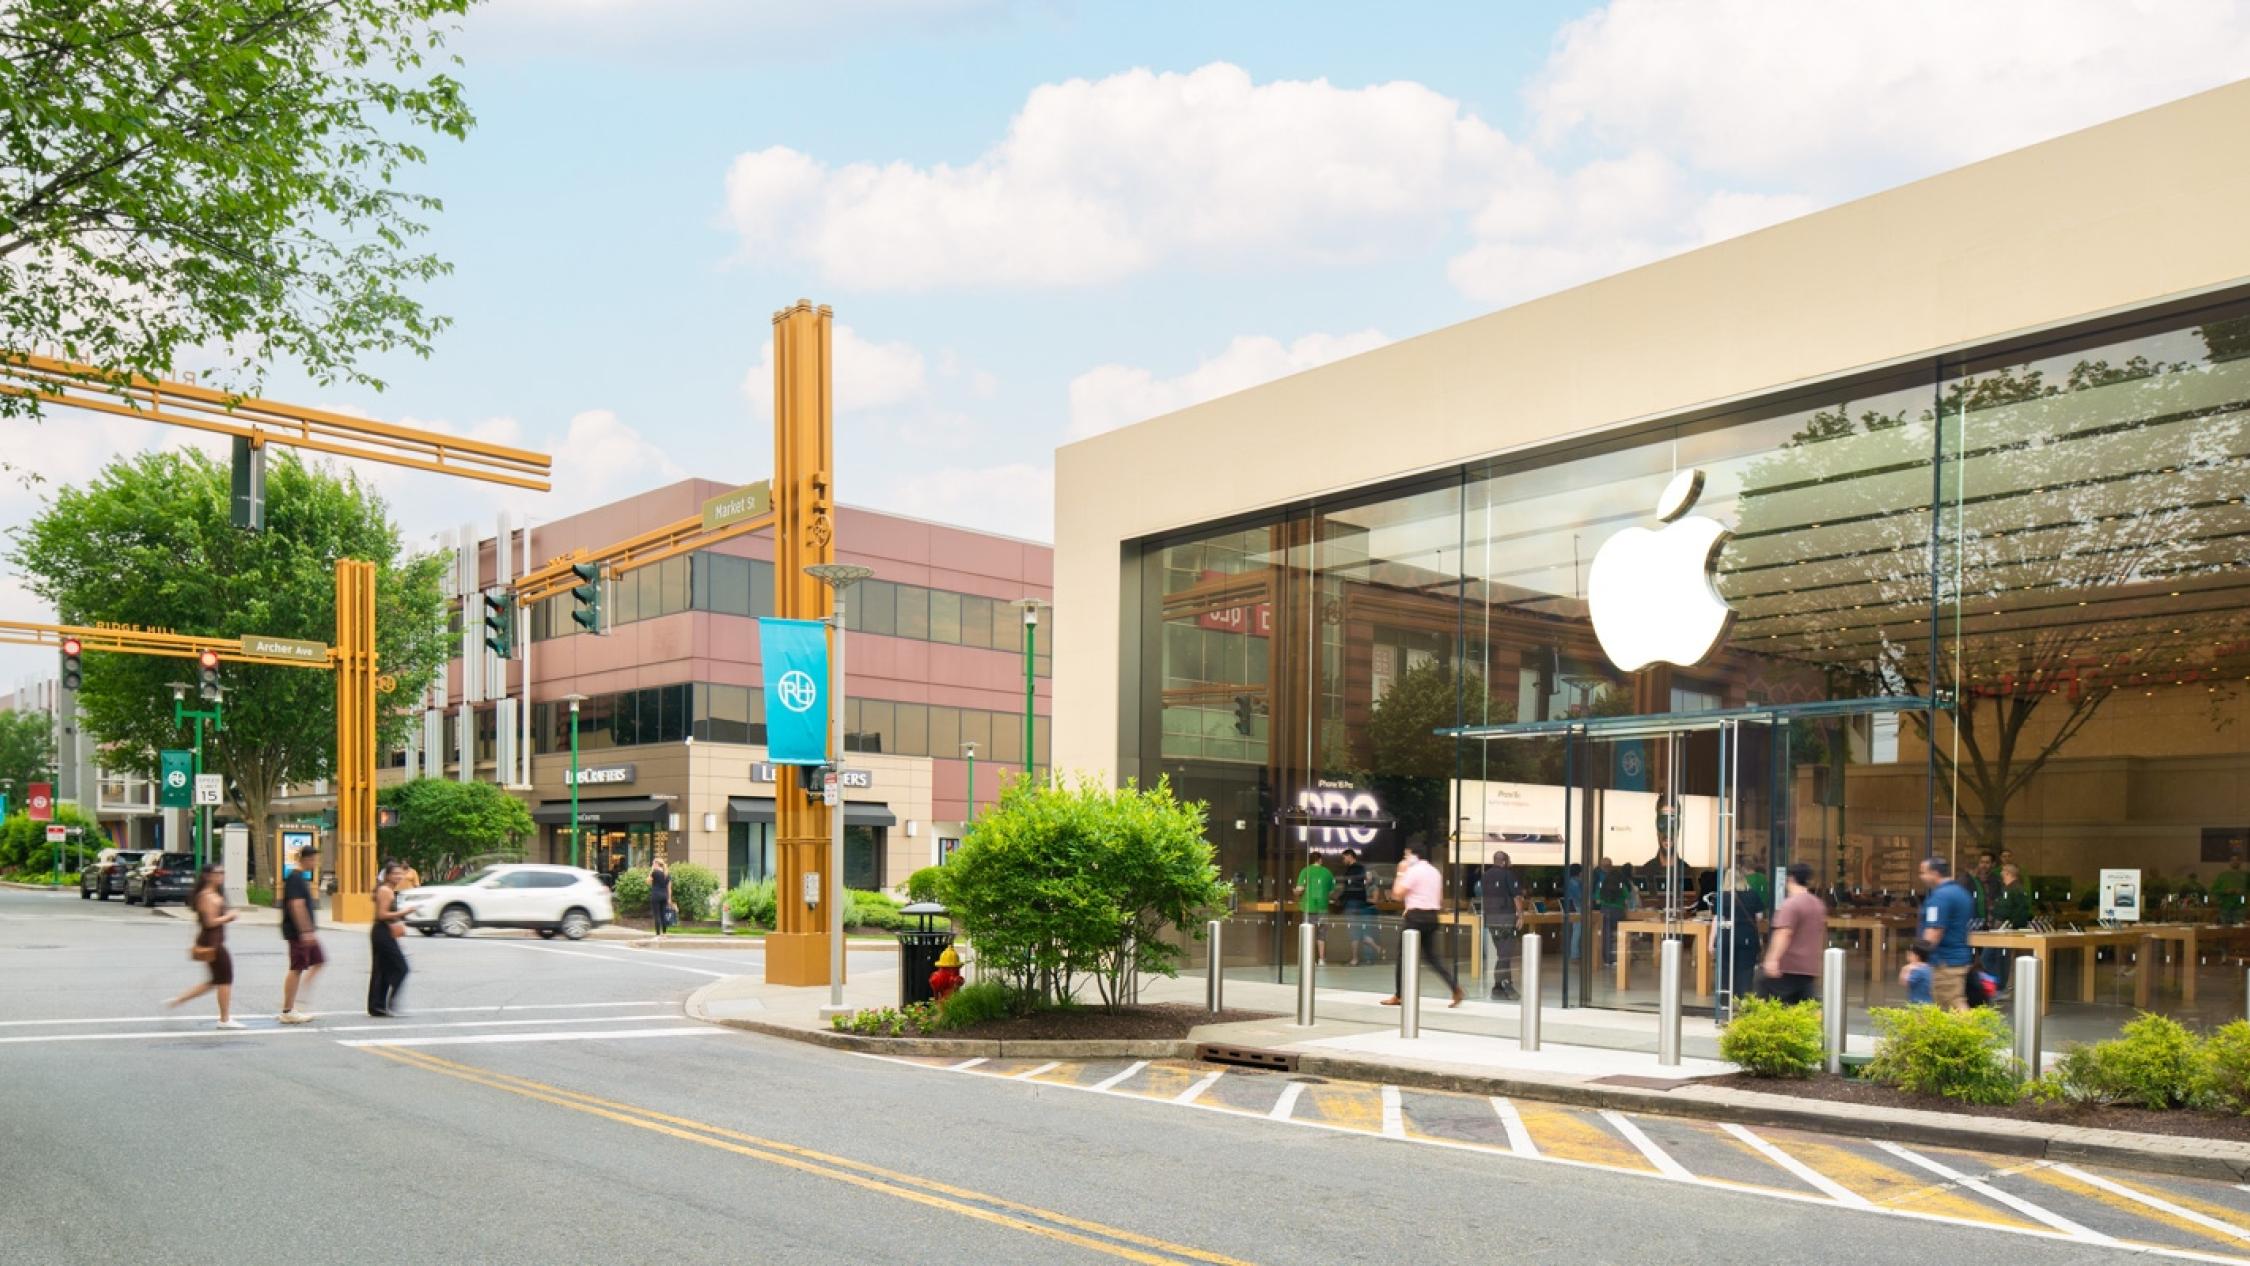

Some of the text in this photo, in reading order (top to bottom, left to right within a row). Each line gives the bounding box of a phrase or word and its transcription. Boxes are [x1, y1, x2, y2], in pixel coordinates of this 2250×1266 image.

[715, 496, 755, 519] Market St
[256, 641, 313, 656] Archer Ave
[201, 790, 217, 801] 15
[1299, 790, 1378, 844] PRO
